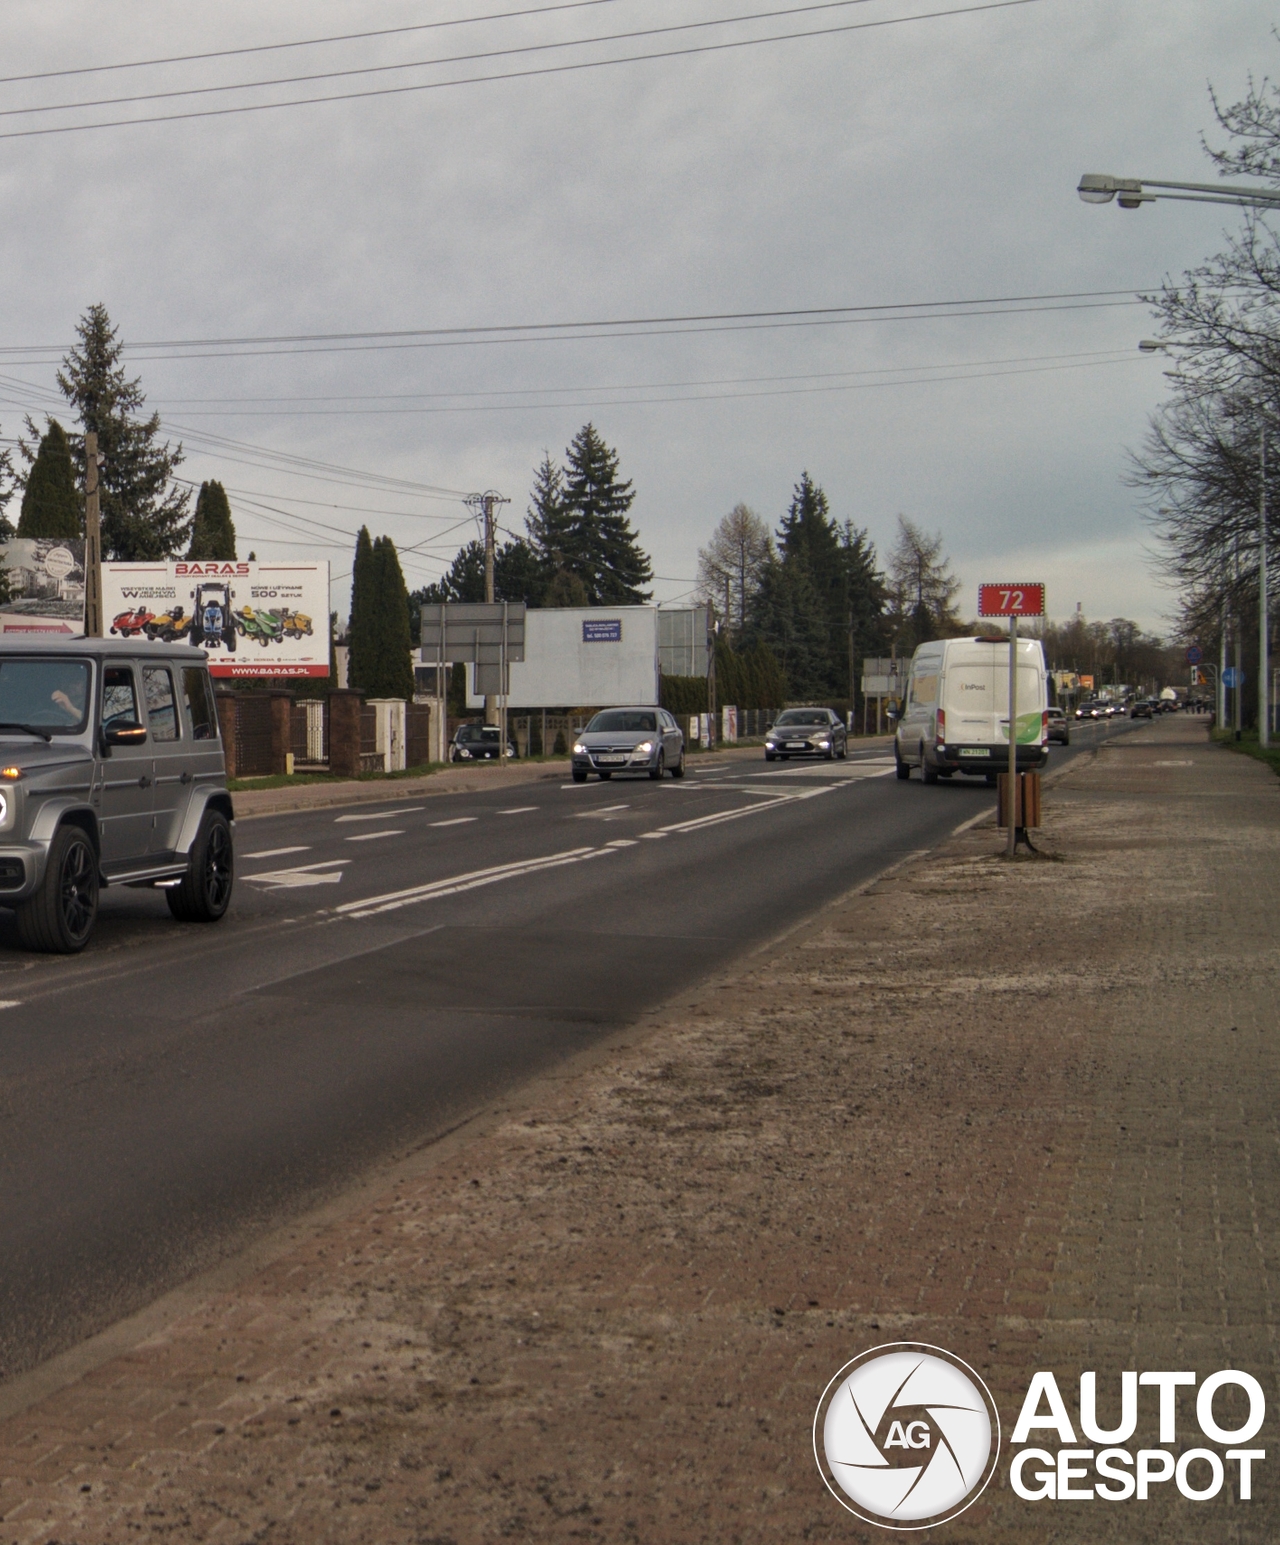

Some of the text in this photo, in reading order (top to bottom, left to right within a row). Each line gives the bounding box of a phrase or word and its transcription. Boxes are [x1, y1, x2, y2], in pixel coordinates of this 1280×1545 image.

[175, 563, 250, 574] BARAS
[122, 591, 139, 599] W
[251, 590, 278, 598] 500
[999, 590, 1024, 610] 72
